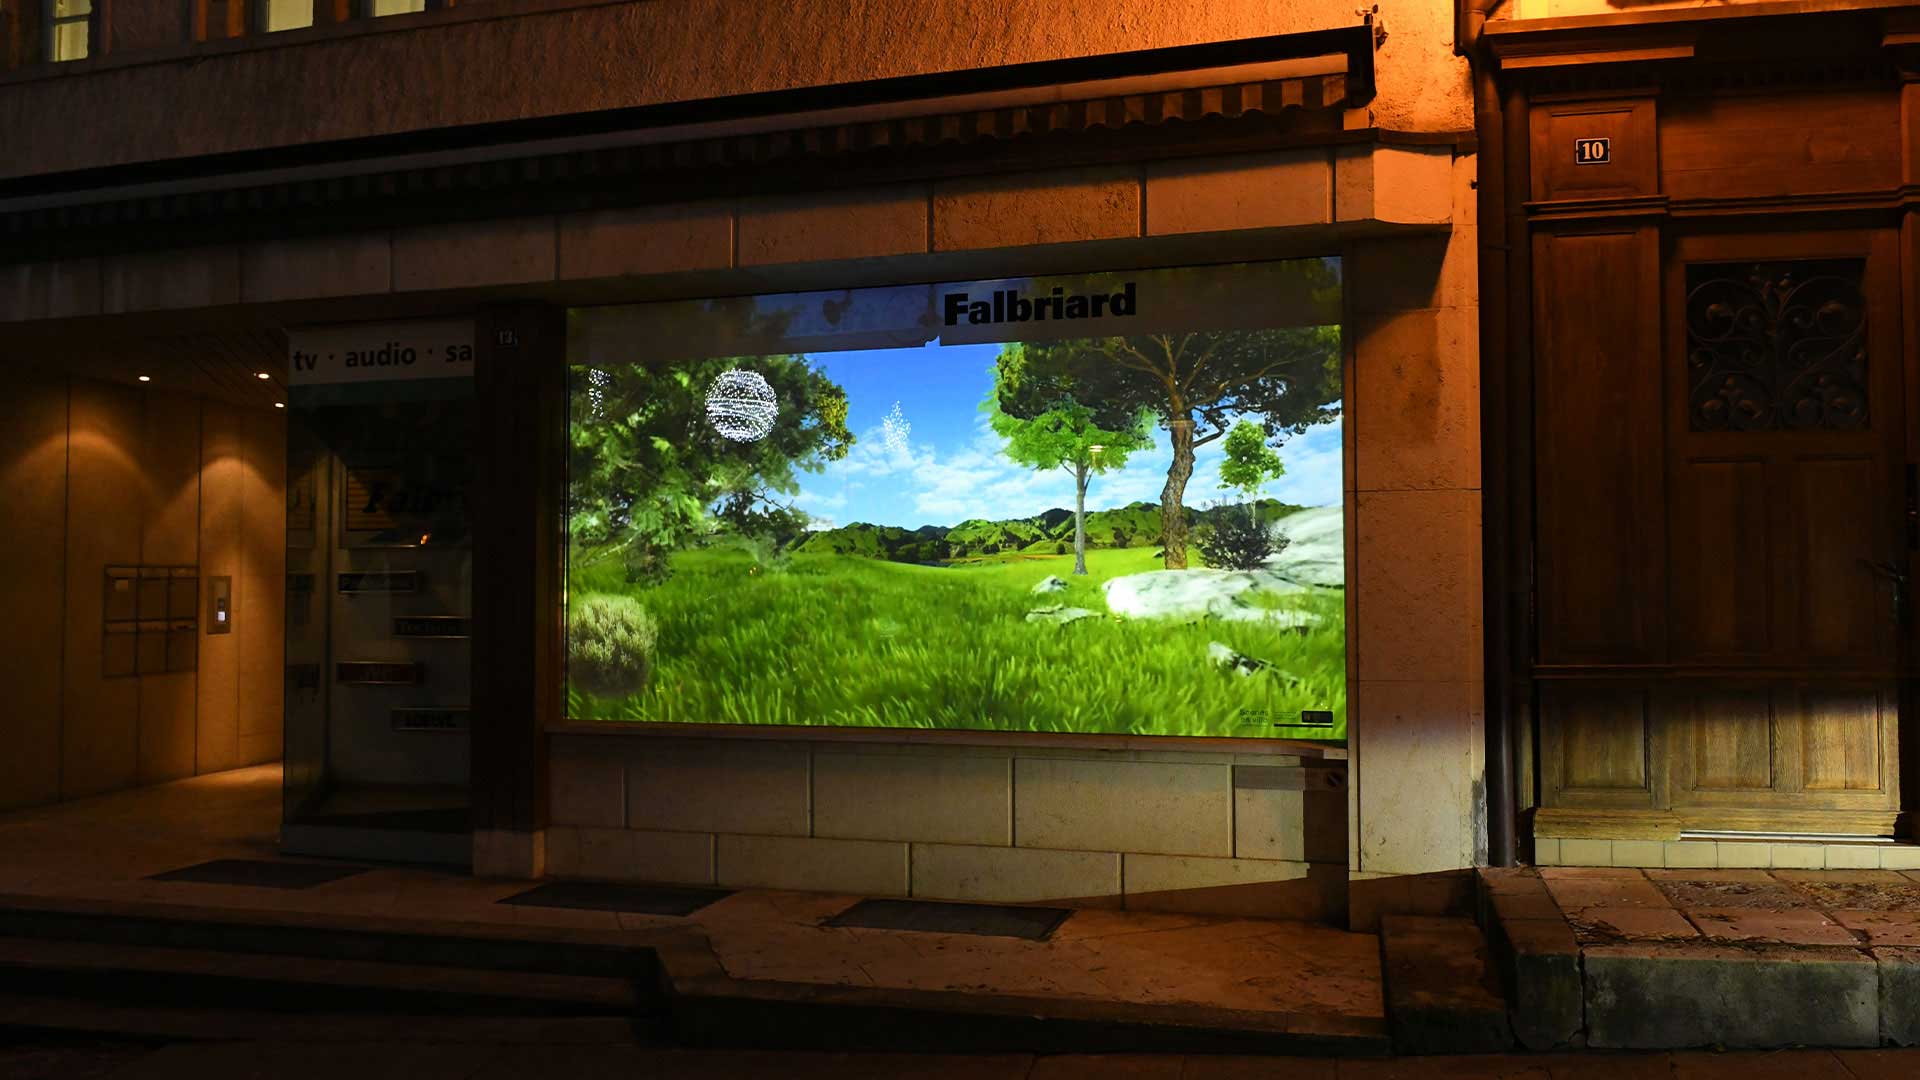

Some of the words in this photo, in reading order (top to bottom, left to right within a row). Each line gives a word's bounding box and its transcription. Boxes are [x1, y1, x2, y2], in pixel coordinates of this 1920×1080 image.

[1582, 141, 1604, 160] 10
[944, 282, 1137, 327] Falbriard
[293, 351, 318, 371] tv
[345, 342, 417, 368] audio
